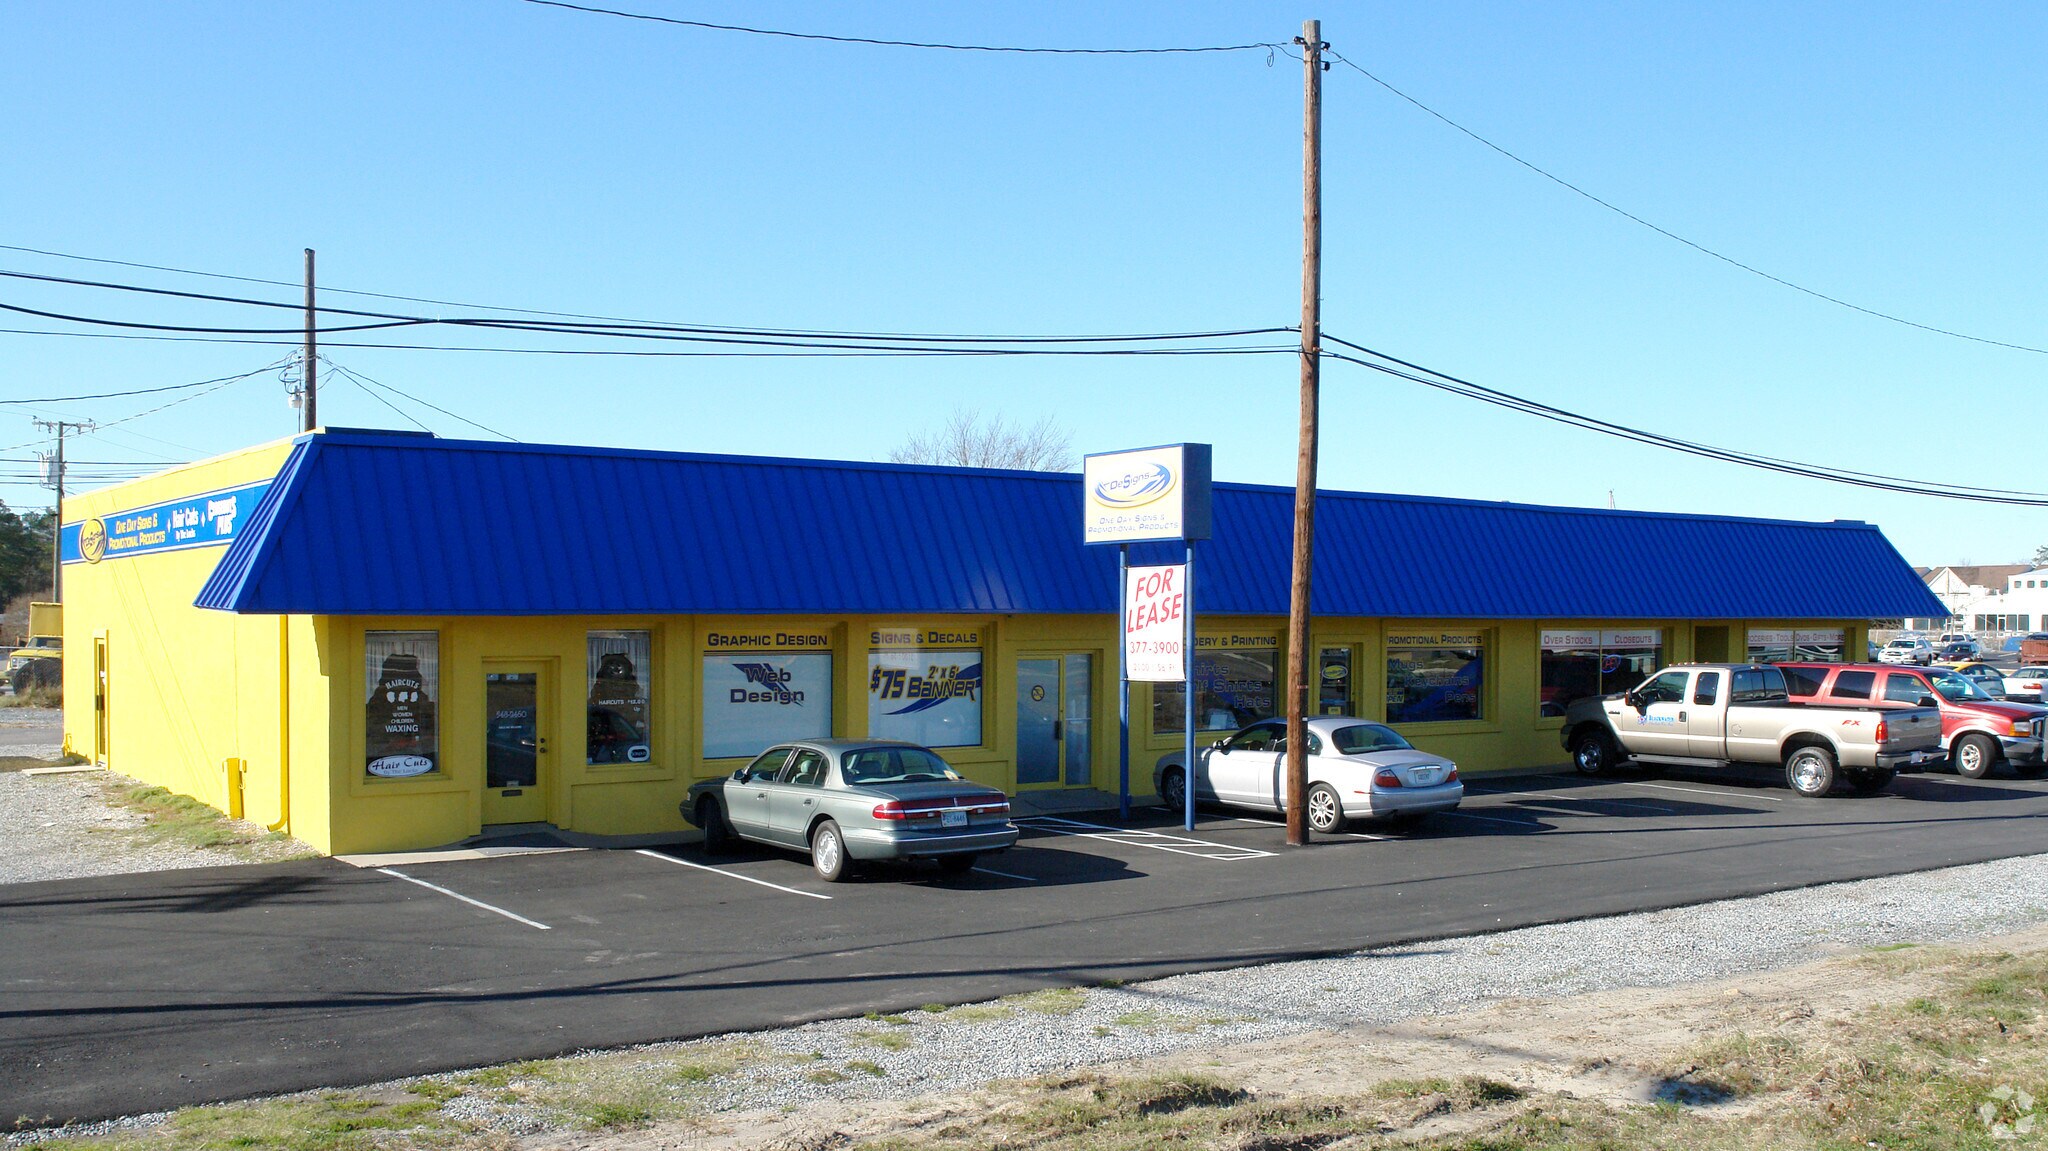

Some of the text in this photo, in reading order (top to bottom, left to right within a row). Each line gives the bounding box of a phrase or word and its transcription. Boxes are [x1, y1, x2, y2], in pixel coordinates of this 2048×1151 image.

[1099, 517, 1114, 525] ONE
[1116, 515, 1131, 523] DAY
[1135, 514, 1158, 522] SIGNS
[1088, 522, 1179, 534] PROMOTIONAL PRODUCTS
[139, 531, 166, 546] PRODUCTS
[1135, 567, 1174, 602] FOR
[1127, 593, 1183, 633] LEASE
[708, 633, 828, 646] GRAPHIC DESIGN
[870, 631, 977, 644] SIGNS & DECALS
[1221, 637, 1228, 646] &
[1231, 635, 1277, 645] PRINTING
[1388, 635, 1482, 645] ROMOTIONAL PRODUCTS
[1544, 635, 1593, 645] OVER STOCKS
[1614, 635, 1652, 643] CLOSEOUTS
[1129, 641, 1179, 654] 377-3900
[1194, 663, 1230, 676] hirts
[1388, 658, 1424, 671] Mugs
[745, 668, 791, 682] Web
[870, 664, 906, 699] $75
[385, 678, 419, 690] HAIRCUTS
[1213, 678, 1262, 693] Shirts
[1403, 675, 1470, 689] Keychains
[730, 688, 804, 704] Design
[1234, 694, 1272, 708] Hats
[1444, 690, 1477, 703] Pens
[385, 724, 419, 733] WAXING
[372, 757, 428, 771] Hair Cuts
